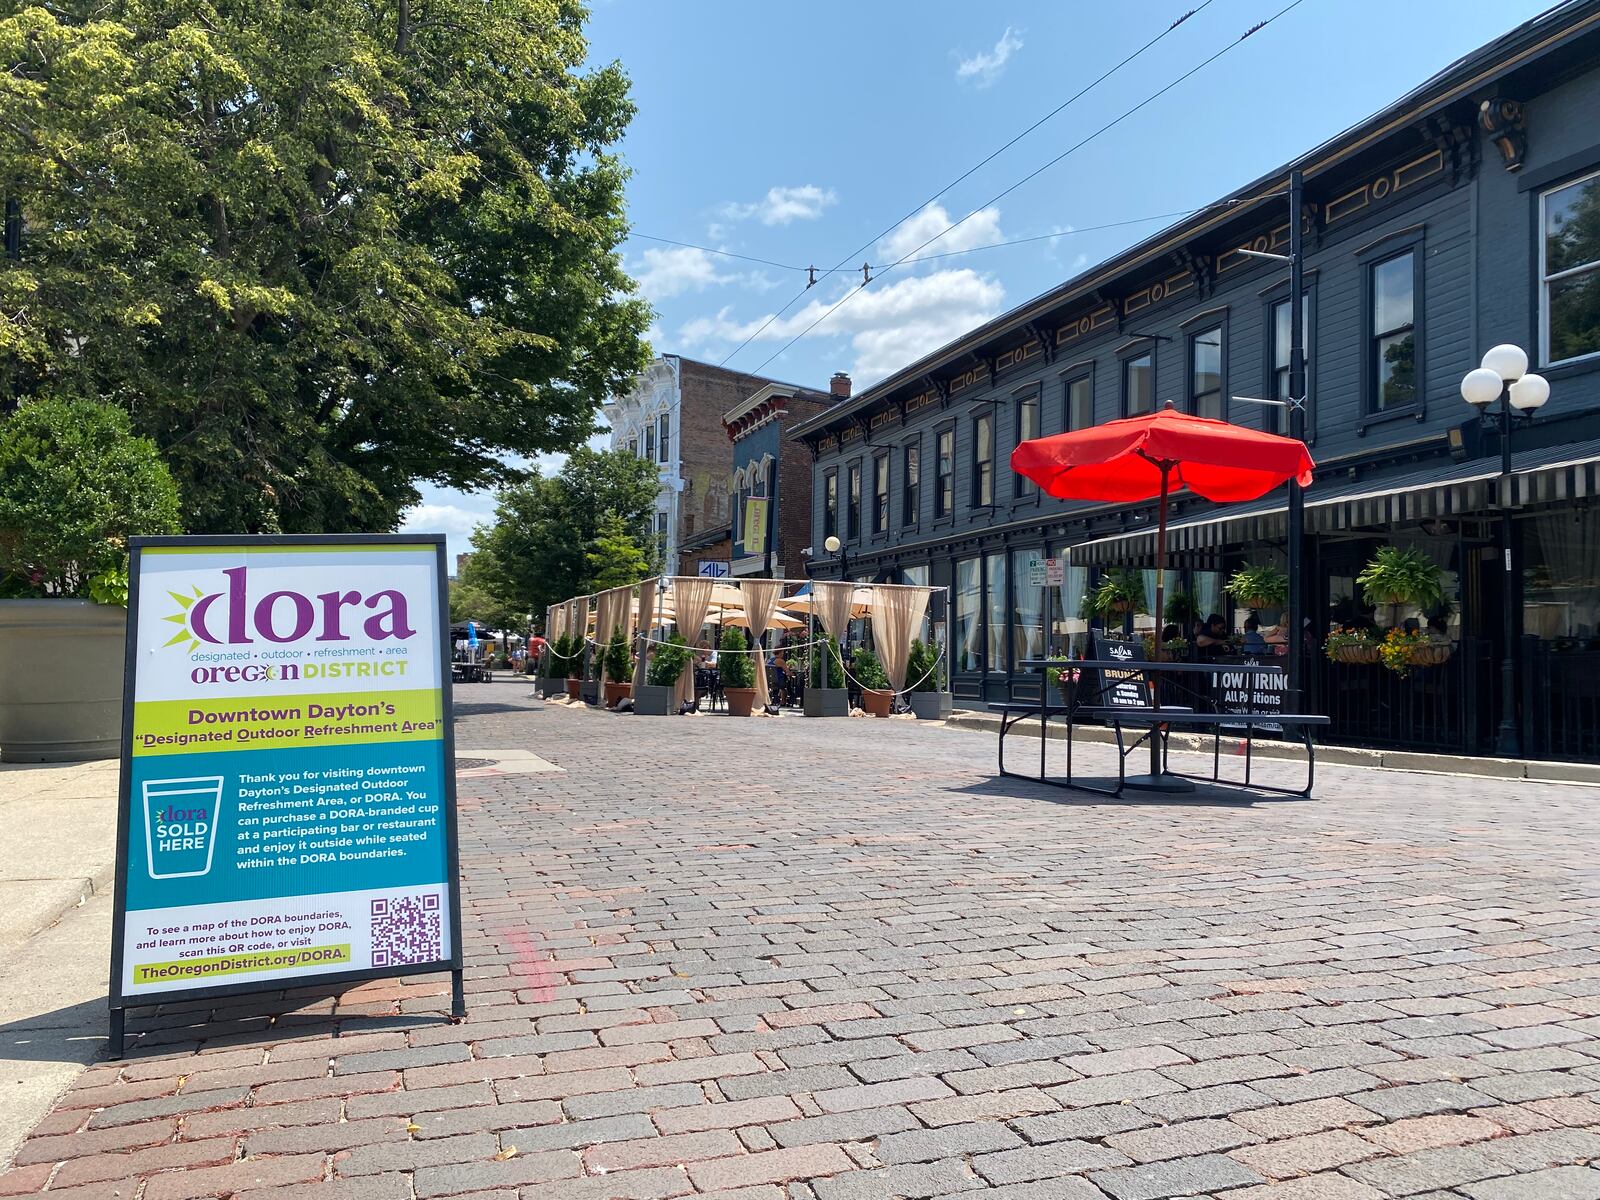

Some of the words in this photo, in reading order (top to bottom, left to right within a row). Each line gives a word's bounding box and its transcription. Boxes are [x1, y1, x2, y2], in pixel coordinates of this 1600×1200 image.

[190, 566, 417, 644] dora
[191, 651, 251, 662] designated
[261, 650, 304, 660] outdoor
[314, 647, 375, 657] refreshment
[386, 647, 408, 655] area
[303, 661, 408, 679] DISTRICT
[1224, 690, 1238, 702] All
[1239, 691, 1281, 705] Poitions
[188, 708, 301, 725] Downtown
[308, 701, 396, 721] Dayton’s
[135, 730, 233, 748] “Designated
[237, 727, 300, 743] Outdoor
[304, 722, 398, 738] Refreshment
[401, 719, 442, 734] Area”
[239, 773, 276, 784] Thank
[279, 772, 300, 784] you
[303, 770, 320, 780] for
[322, 768, 364, 778] visiting
[366, 765, 426, 776] downtown
[239, 786, 290, 798] Dayton’s
[293, 782, 359, 794] Designated
[361, 779, 409, 790] Outdoor
[238, 799, 314, 812] Refreshment
[317, 797, 347, 807] Area,
[350, 796, 362, 804] or
[365, 792, 403, 803] DORA.
[406, 791, 427, 800] You
[160, 804, 208, 822] dora
[238, 818, 259, 826] can
[262, 813, 317, 826] purchase
[330, 805, 416, 820] DORA-branded
[418, 804, 439, 814] cup
[156, 822, 208, 838] SOLD
[238, 831, 250, 840] at
[264, 825, 338, 840] participating
[340, 824, 360, 833] bar
[378, 817, 437, 830] restaurant
[160, 836, 204, 852] HERE
[237, 844, 260, 855] and
[263, 842, 296, 854] enjoy
[299, 840, 307, 850] it
[310, 838, 353, 849] outside
[356, 834, 387, 845] while
[389, 832, 428, 842] seated
[236, 858, 275, 870] within
[278, 856, 298, 866] the
[300, 852, 337, 864] DORA
[340, 848, 408, 861] boundaries.
[146, 927, 160, 936] To
[162, 926, 180, 934] see
[192, 923, 215, 932] map
[218, 920, 228, 929] of
[230, 920, 248, 928] the
[250, 916, 282, 926] DORA
[284, 910, 343, 923] boundaries,
[136, 940, 156, 950] and
[159, 938, 186, 948] learn
[188, 936, 216, 944] more
[218, 932, 249, 941] about
[251, 930, 273, 938] how
[276, 928, 286, 936] to
[288, 925, 316, 935] enjoy
[318, 922, 352, 932] DORA,
[178, 949, 204, 958] scan
[206, 946, 226, 955] this
[228, 944, 245, 953] QR
[247, 942, 275, 951] code,
[278, 940, 288, 948] or
[290, 938, 312, 947] visit
[141, 948, 346, 979] TheOregonDistrict.org/DORA.
